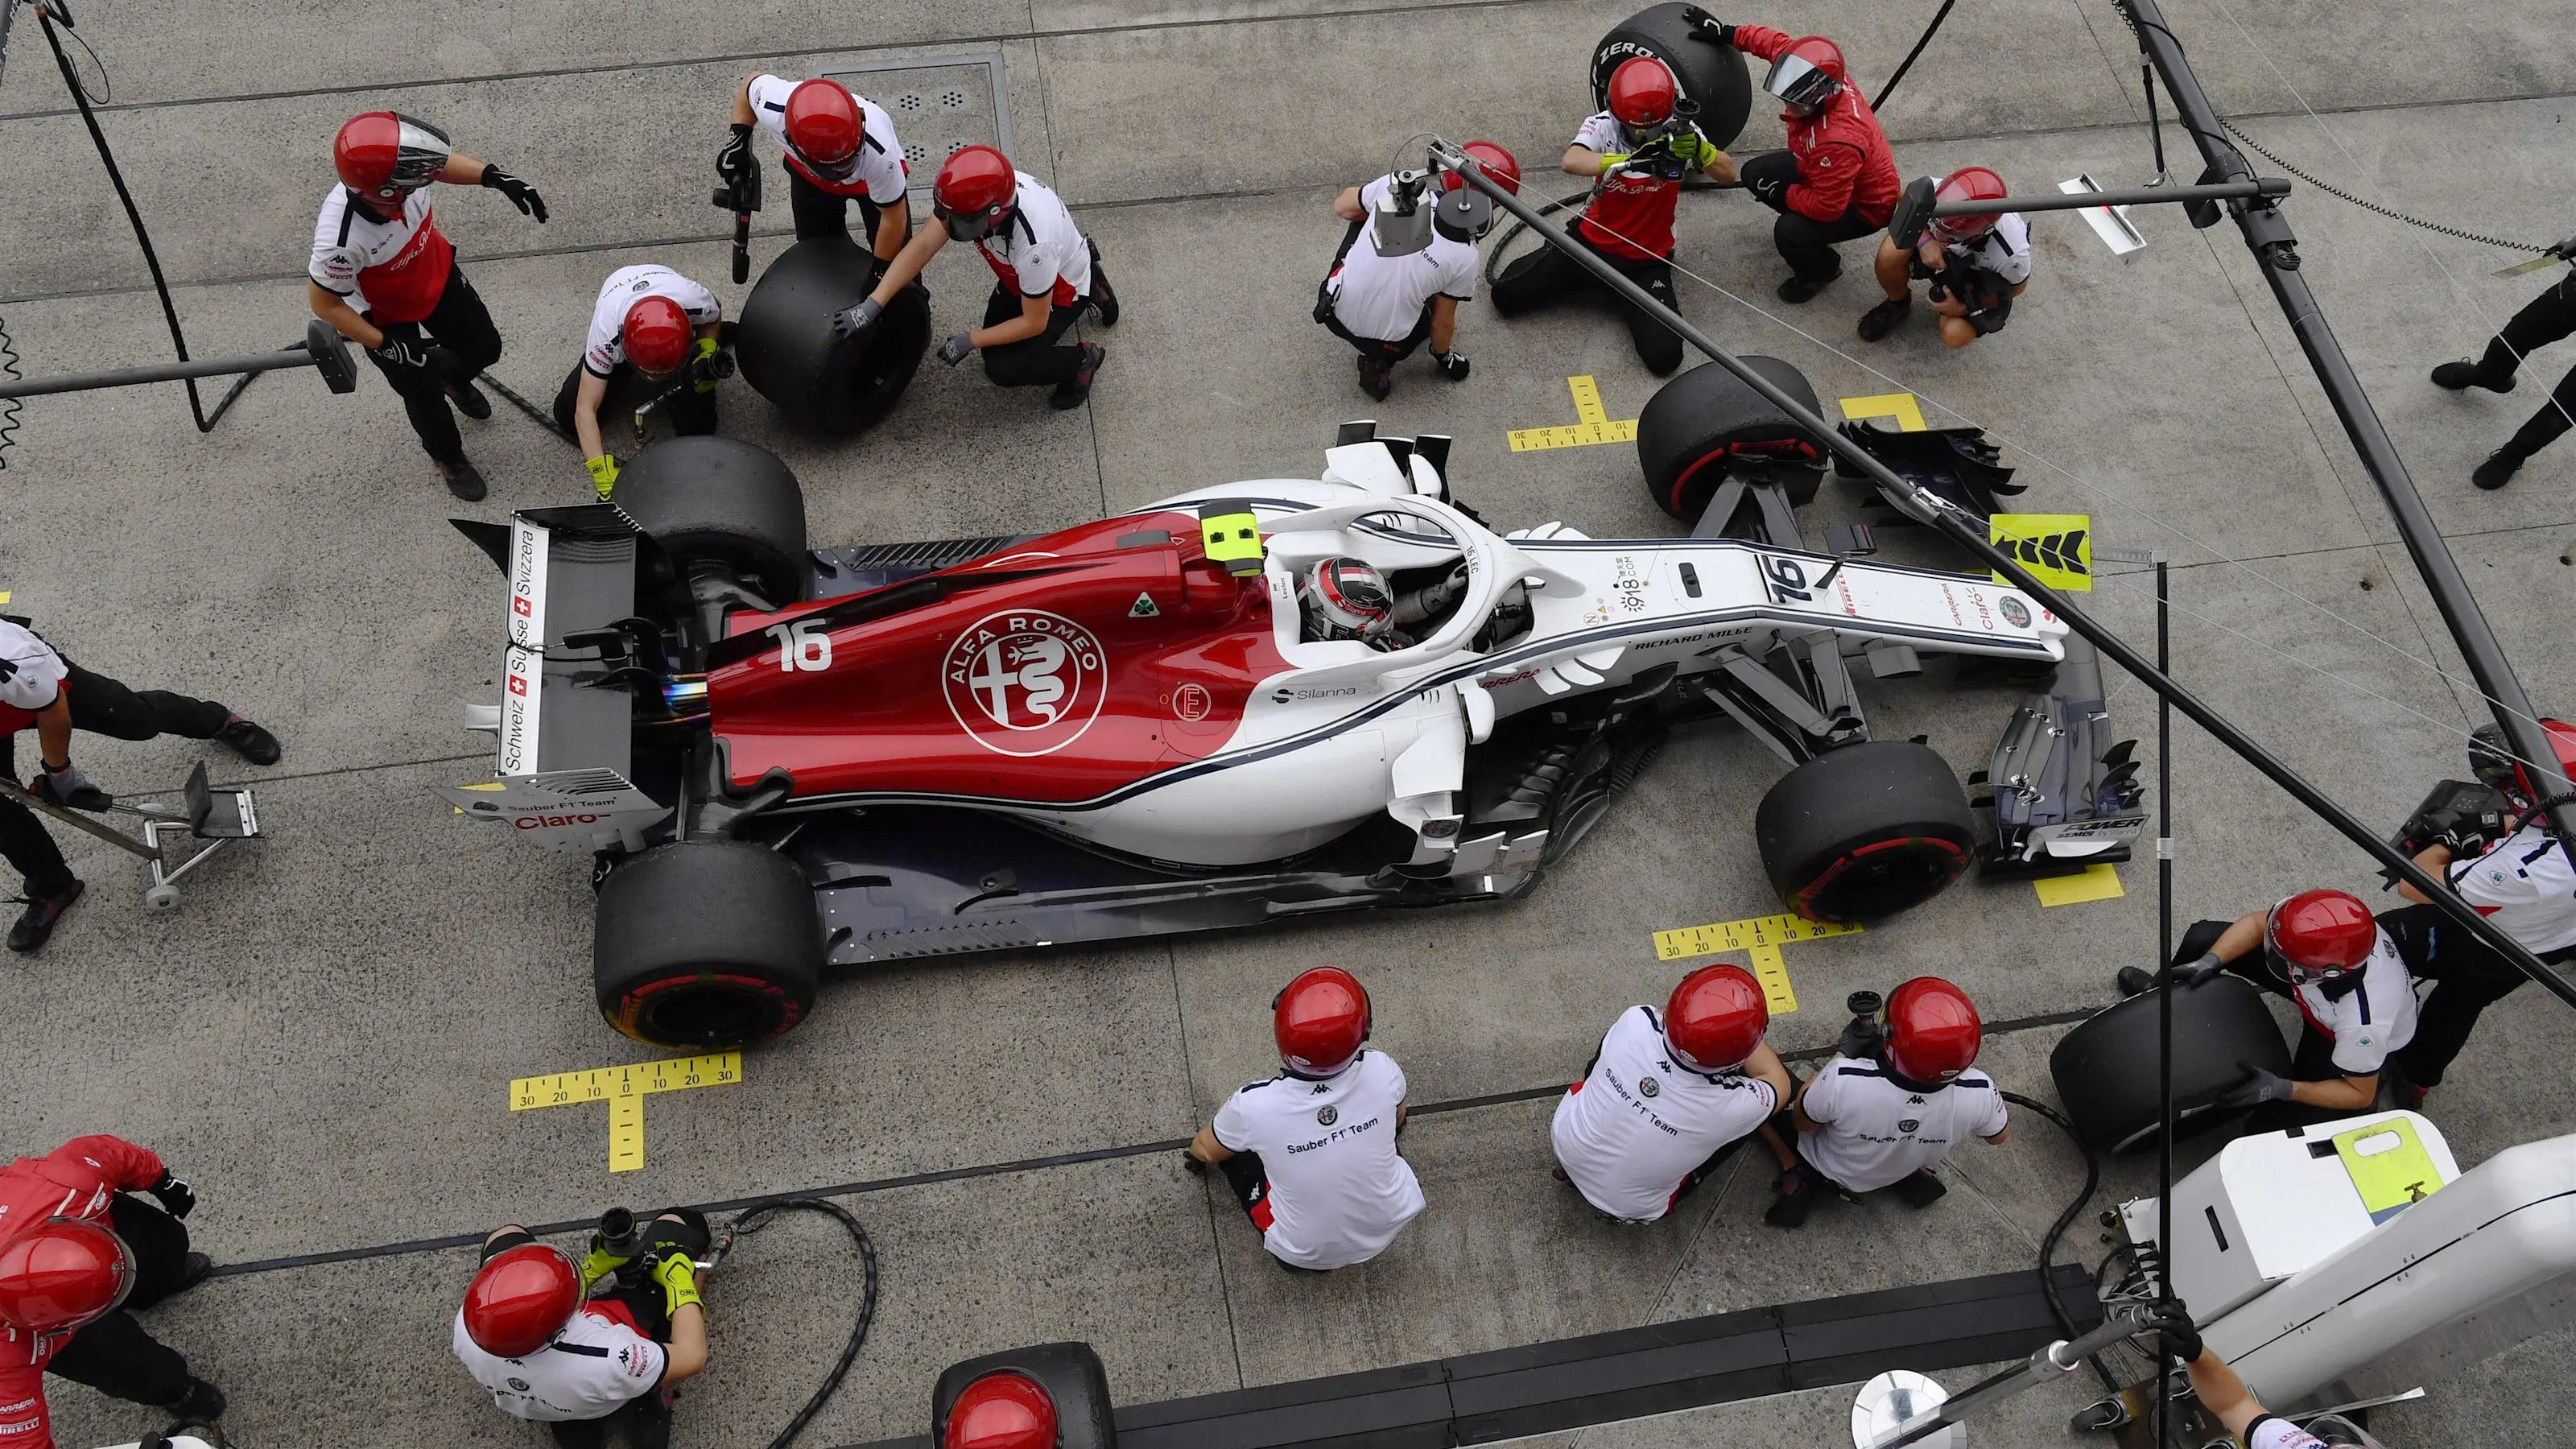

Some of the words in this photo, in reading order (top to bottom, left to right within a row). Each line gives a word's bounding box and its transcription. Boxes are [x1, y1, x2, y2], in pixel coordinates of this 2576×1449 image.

[1600, 42, 1653, 66] ZERO
[1420, 248, 1439, 269] Team
[1514, 431, 1526, 440] 30
[1540, 429, 1552, 437] 20
[517, 530, 533, 596] Svizzera
[1465, 545, 1472, 556] 16
[1469, 556, 1479, 574] LEC
[1761, 555, 1812, 604] 16
[1345, 604, 1366, 616] Silanna
[1941, 583, 1962, 626] CARRERA
[1973, 592, 1994, 630] Claro
[765, 618, 832, 672] 16
[951, 629, 996, 684] ALFA
[1009, 617, 1098, 671] ROMEO
[1635, 634, 1703, 650] RICHARD
[1707, 626, 1753, 640] MILLE
[1298, 687, 1356, 700] Silanna
[506, 699, 523, 771] Schweiz
[2062, 818, 2145, 832] POWER
[1666, 947, 1680, 956] 30
[1695, 943, 1710, 953] 20
[1724, 938, 1739, 947] 10
[1757, 935, 1765, 943] 0
[1783, 930, 1797, 939] 10
[1811, 926, 1826, 935] 20
[1842, 923, 1855, 932] 30
[520, 1096, 535, 1107] 30
[553, 1092, 568, 1102] 20
[587, 1087, 601, 1097] 10
[622, 1083, 630, 1093] 0
[653, 1079, 667, 1089] 10
[685, 1075, 700, 1085] 20
[718, 1070, 733, 1081] 30
[1605, 1068, 1631, 1101] Sauber
[1650, 1113, 1678, 1137] Team
[1287, 1137, 1327, 1154] Sauber
[1349, 1118, 1378, 1135] Team
[39, 1337, 47, 1356] OMP
